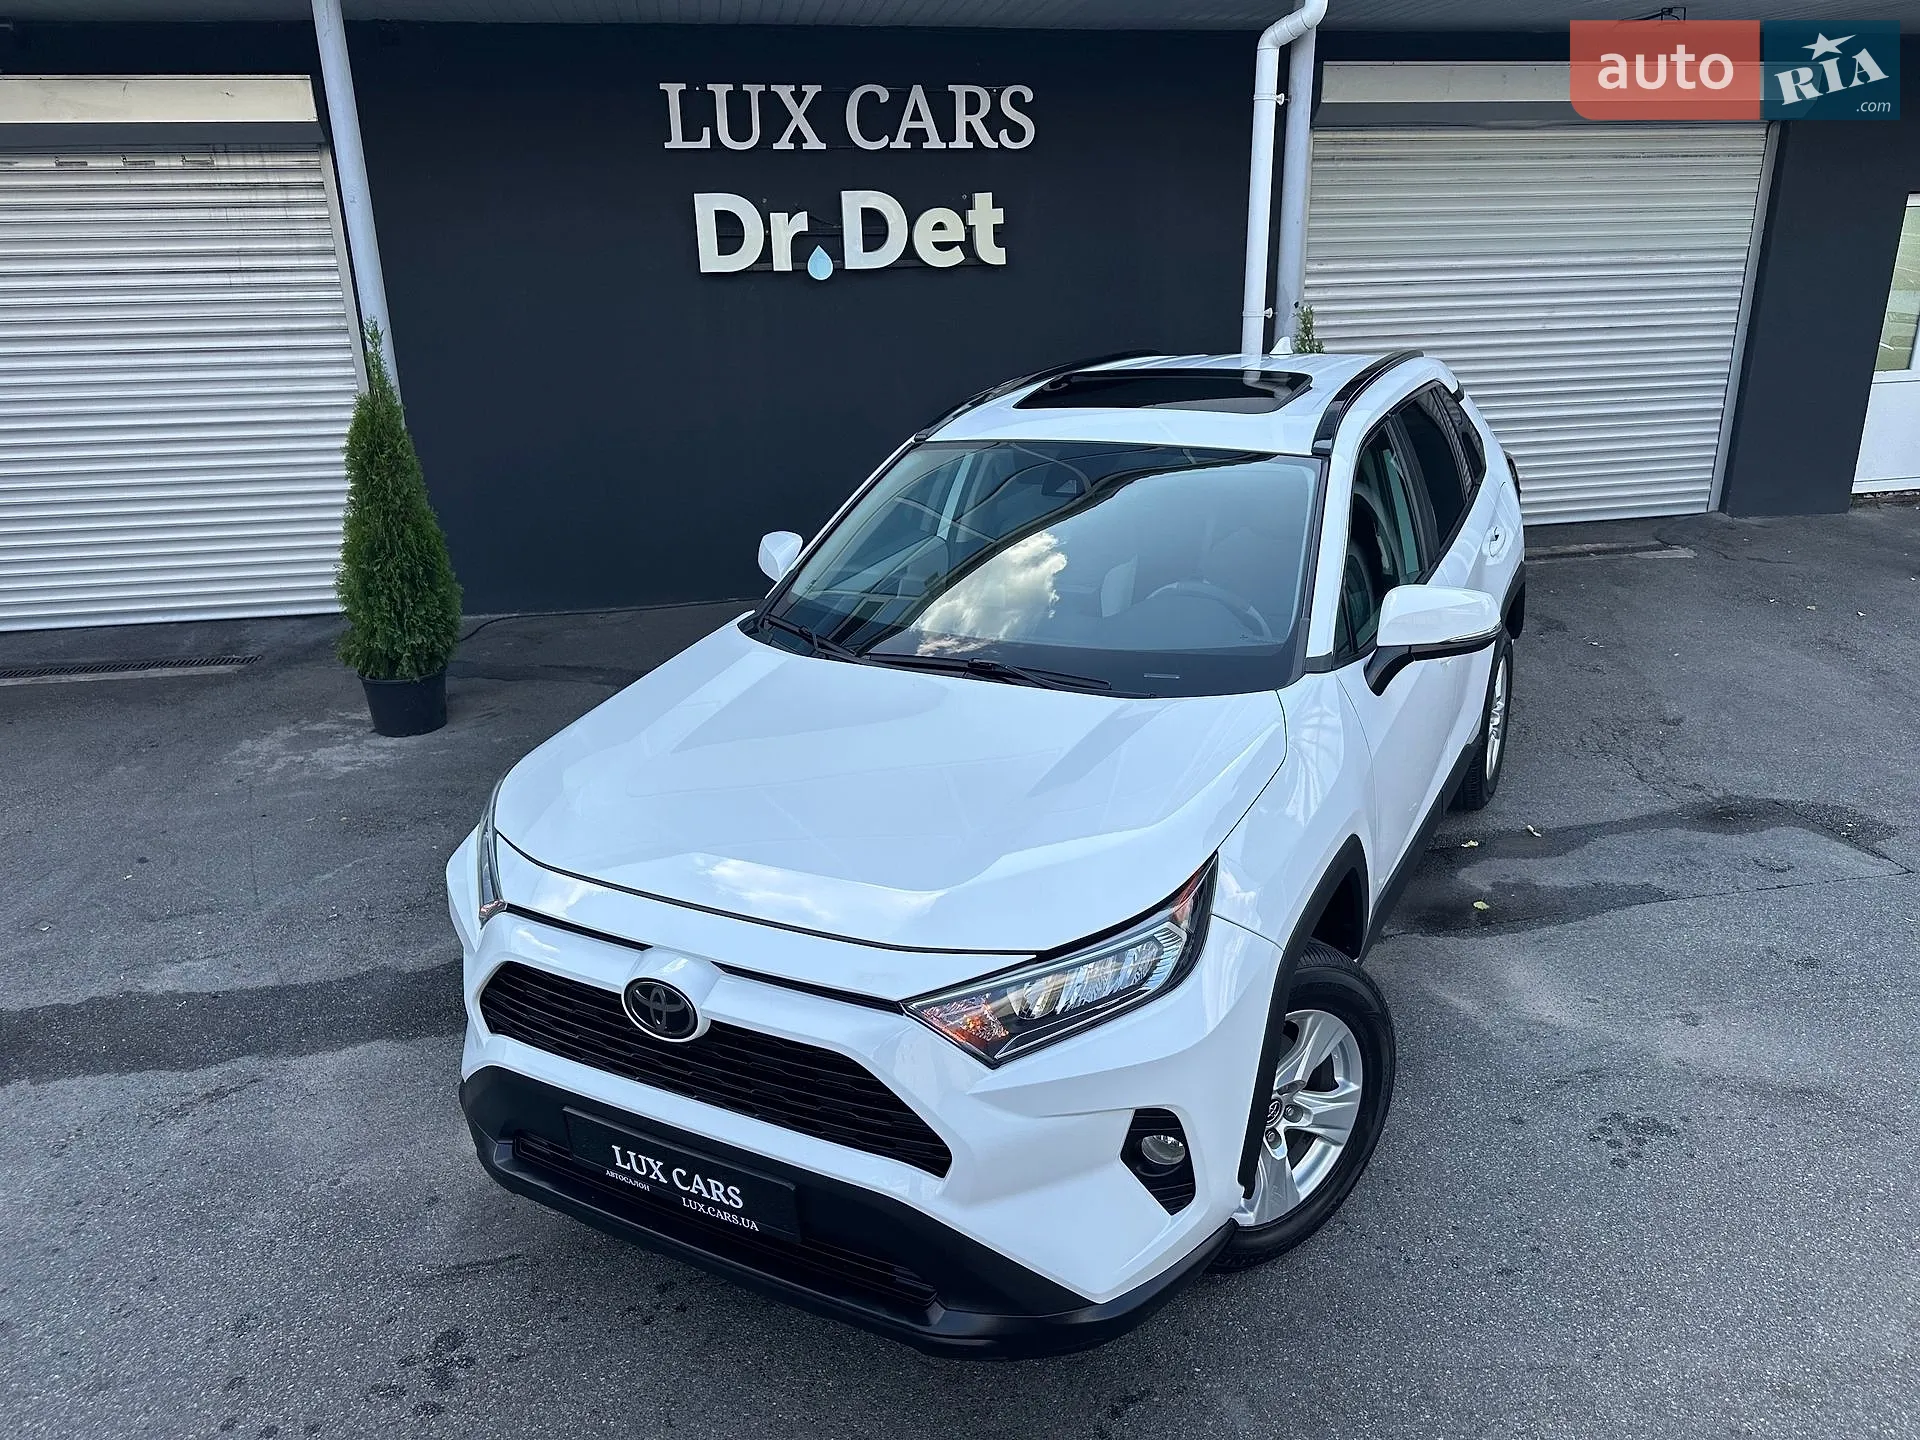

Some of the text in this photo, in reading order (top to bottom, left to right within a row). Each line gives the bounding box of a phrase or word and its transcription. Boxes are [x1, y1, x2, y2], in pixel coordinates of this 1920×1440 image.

[659, 83, 1035, 149] LUX CARS
[605, 1169, 650, 1191] АВТОСАЛОН
[611, 1145, 744, 1209] LUX CARS
